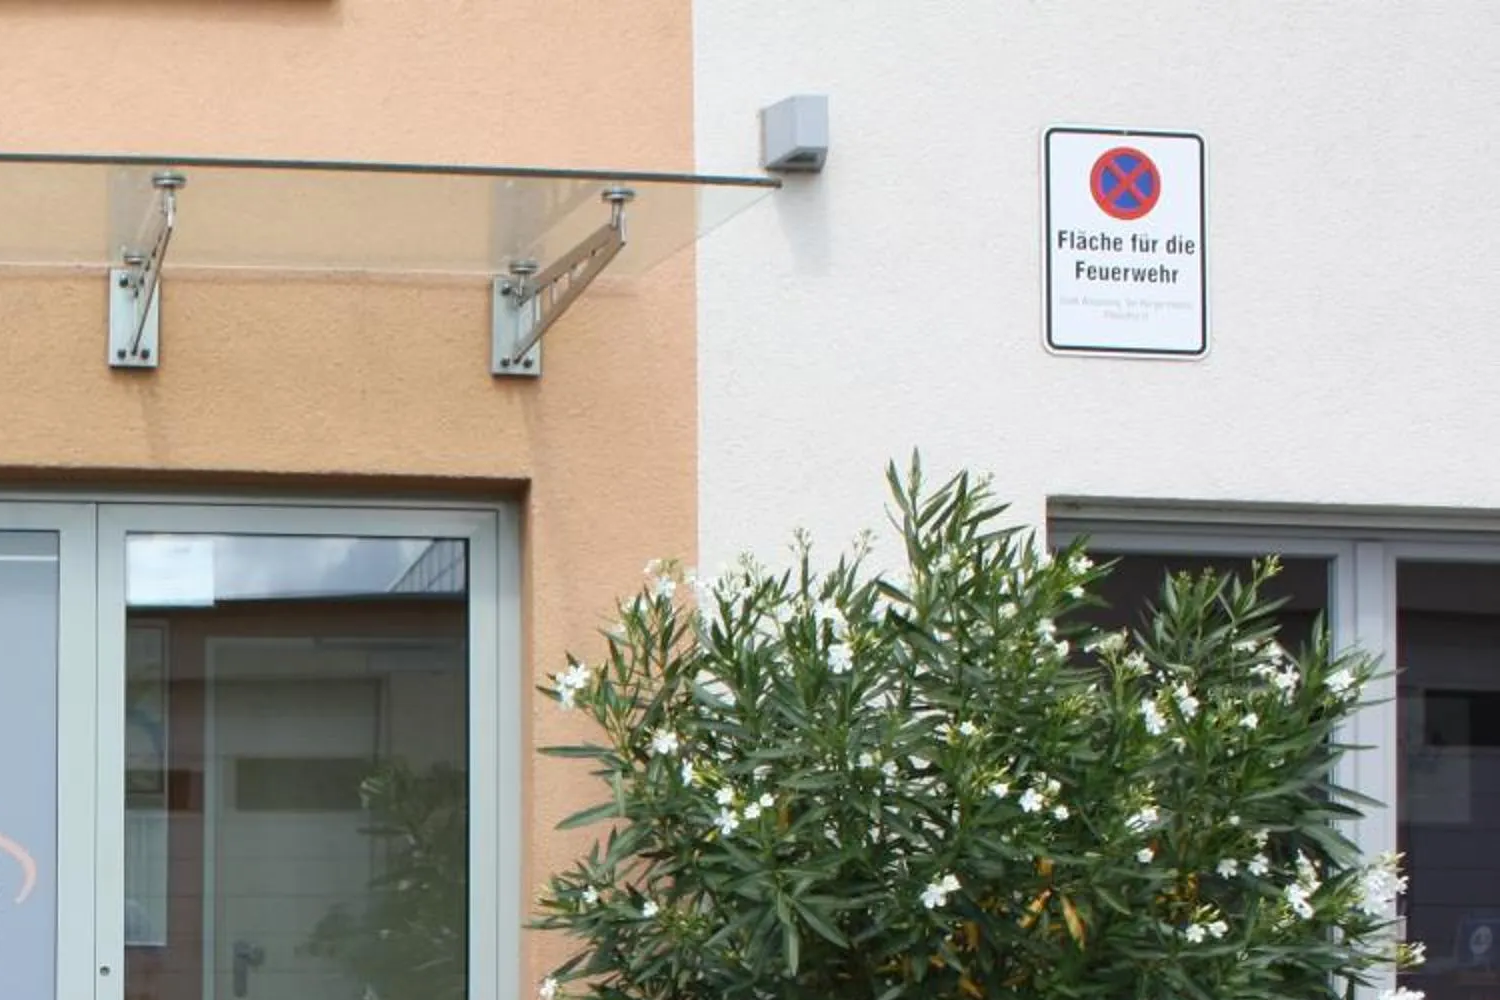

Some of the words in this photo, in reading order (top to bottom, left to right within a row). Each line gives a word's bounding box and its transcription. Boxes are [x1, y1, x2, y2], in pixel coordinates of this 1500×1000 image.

[1057, 229, 1123, 252] Fläche
[1131, 233, 1159, 253] für
[1165, 235, 1196, 256] die
[1075, 260, 1180, 284] Feuerwehr
